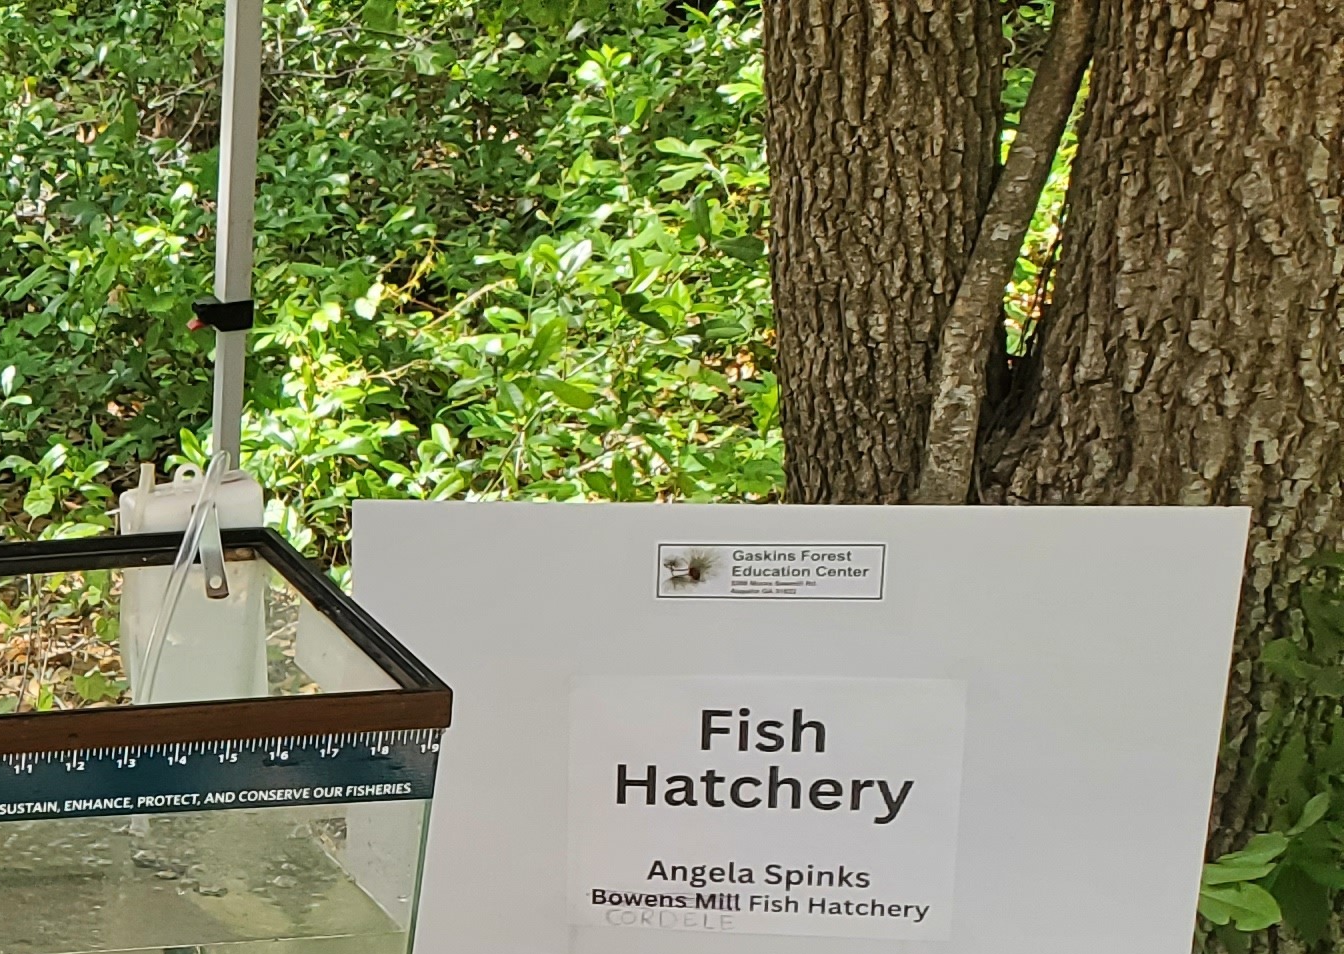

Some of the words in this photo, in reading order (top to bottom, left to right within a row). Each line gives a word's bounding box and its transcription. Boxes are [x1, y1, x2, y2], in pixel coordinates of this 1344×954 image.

[732, 550, 796, 562] Gaskins
[801, 550, 852, 562] Forest
[732, 565, 811, 577] Education
[815, 566, 870, 577] Center
[700, 707, 826, 753] Fish
[64, 797, 134, 812] ENHANCE,
[137, 793, 201, 808] PROTECT,
[203, 792, 236, 804] AND
[238, 788, 311, 802] CONSERVE
[313, 786, 343, 799] OUR
[345, 783, 412, 797] FISHERIES
[615, 763, 915, 825] Hatchery
[646, 860, 755, 888] Angela
[764, 864, 871, 891] Spinks
[591, 888, 688, 909] Bowens
[695, 892, 741, 912] Mill
[748, 895, 799, 914] Fish
[808, 897, 931, 923] Hatchery
[605, 908, 736, 931] CORDELE
